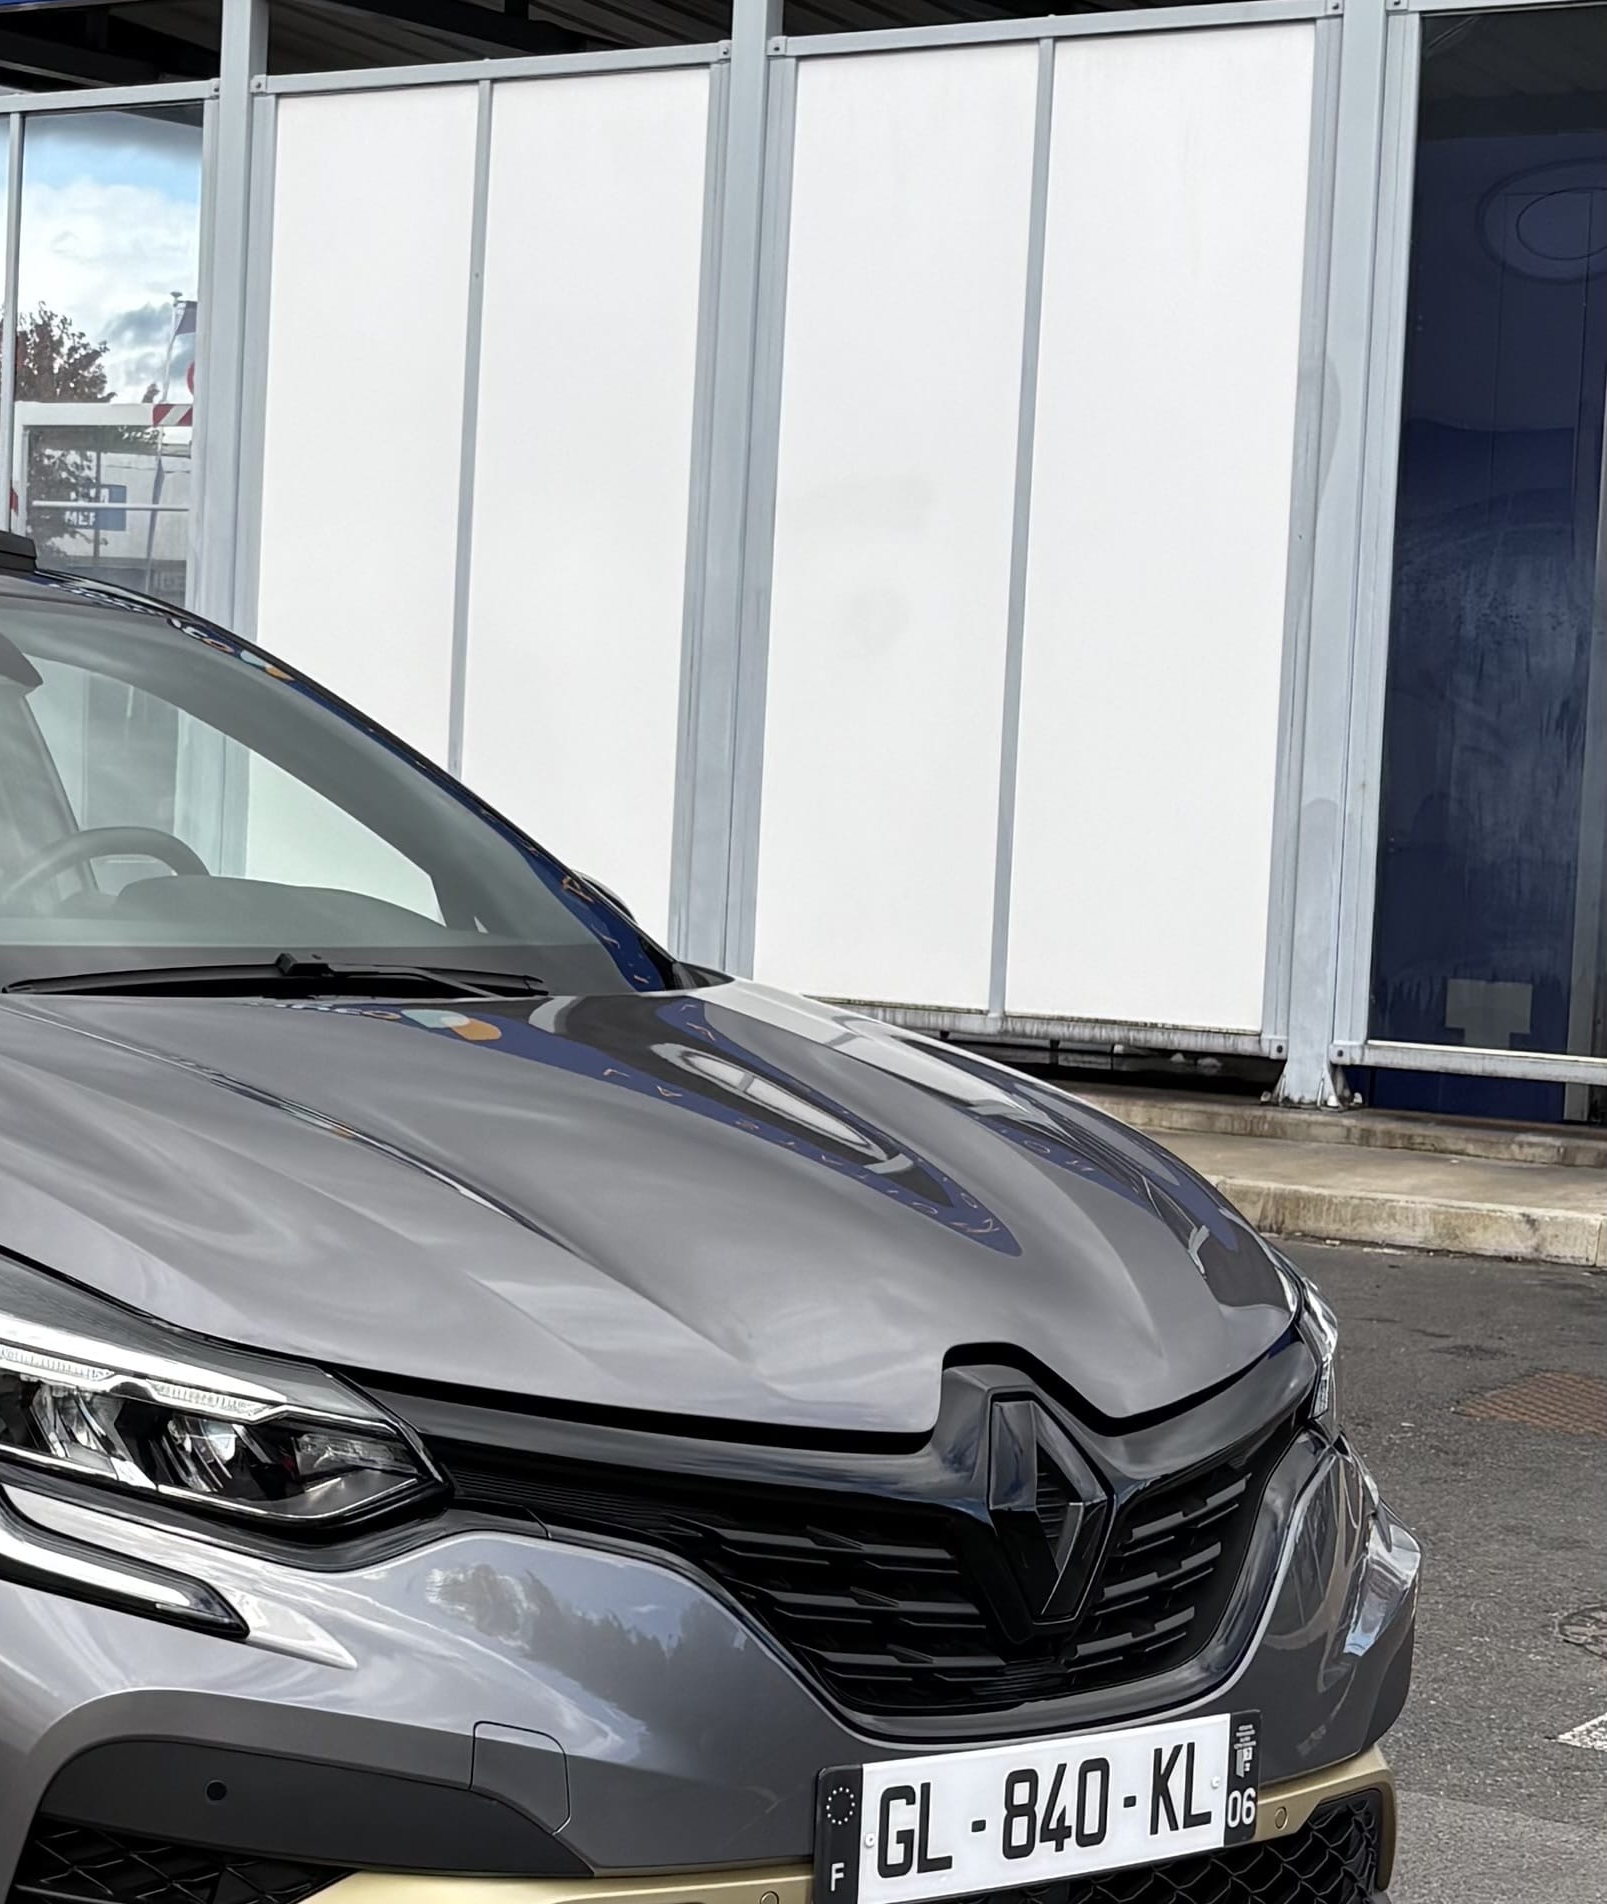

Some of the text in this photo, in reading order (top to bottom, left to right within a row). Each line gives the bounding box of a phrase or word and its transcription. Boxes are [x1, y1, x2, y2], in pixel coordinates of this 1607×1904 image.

[876, 1741, 1212, 1879] GL-840-KL
[1227, 1787, 1257, 1828] 06
[830, 1862, 845, 1892] F
